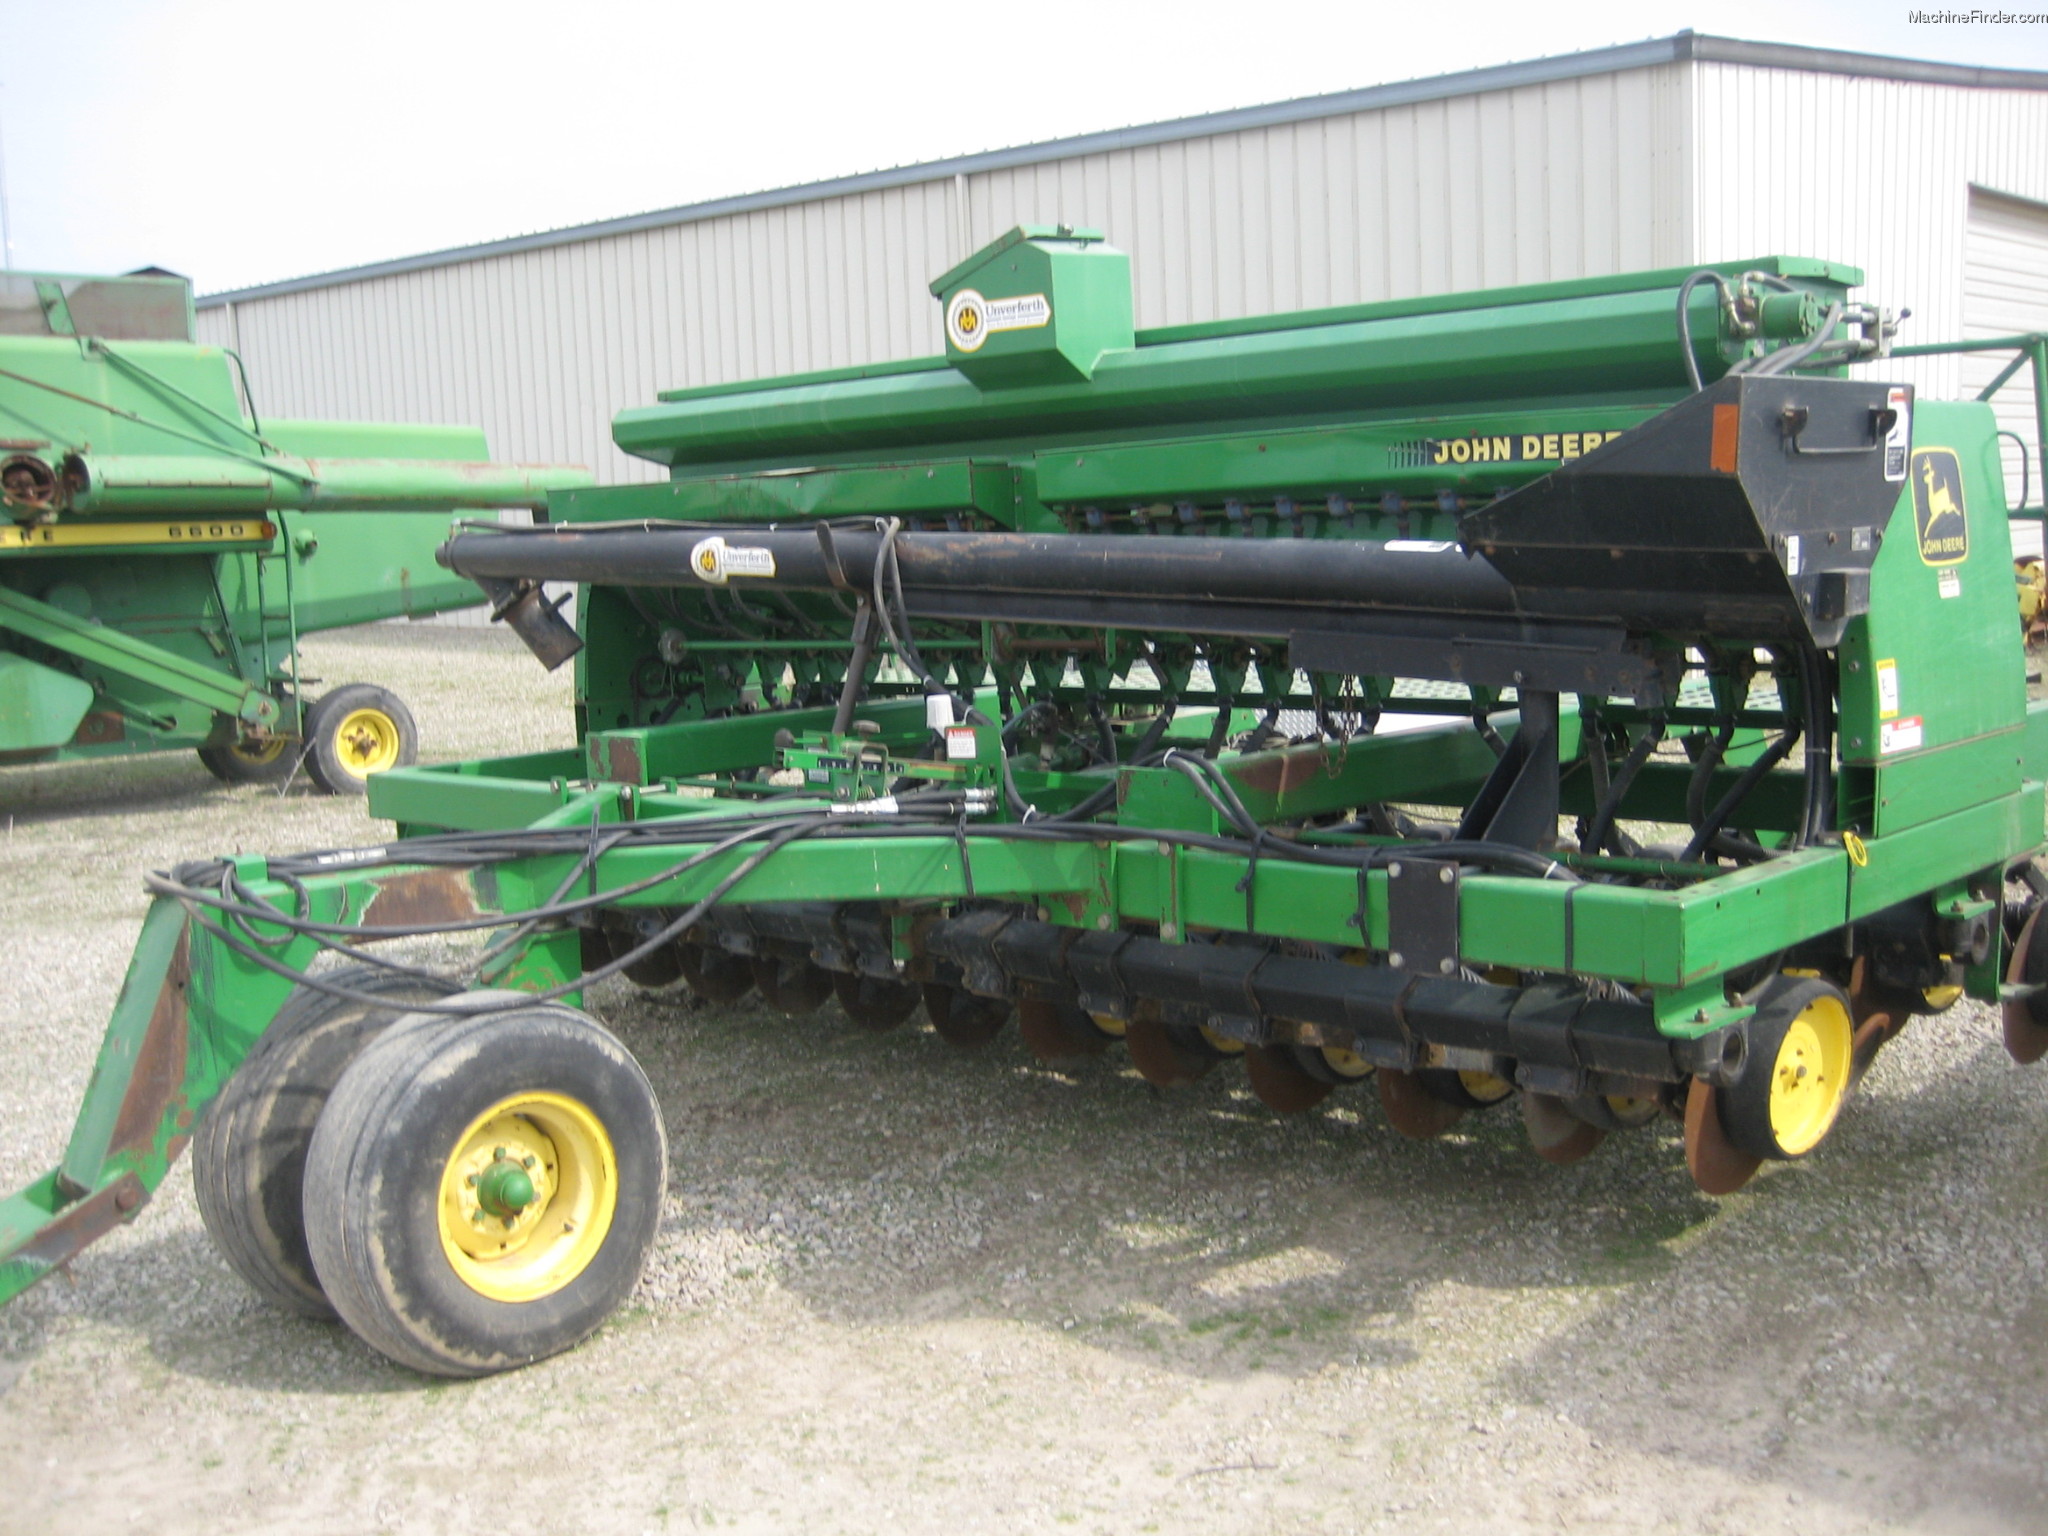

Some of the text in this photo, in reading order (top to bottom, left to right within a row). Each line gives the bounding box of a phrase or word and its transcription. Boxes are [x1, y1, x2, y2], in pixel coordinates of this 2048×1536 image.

[1434, 431, 1623, 464] JOHN DEER
[169, 523, 244, 538] 6600
[1922, 535, 1965, 555] JOHN DEERE
